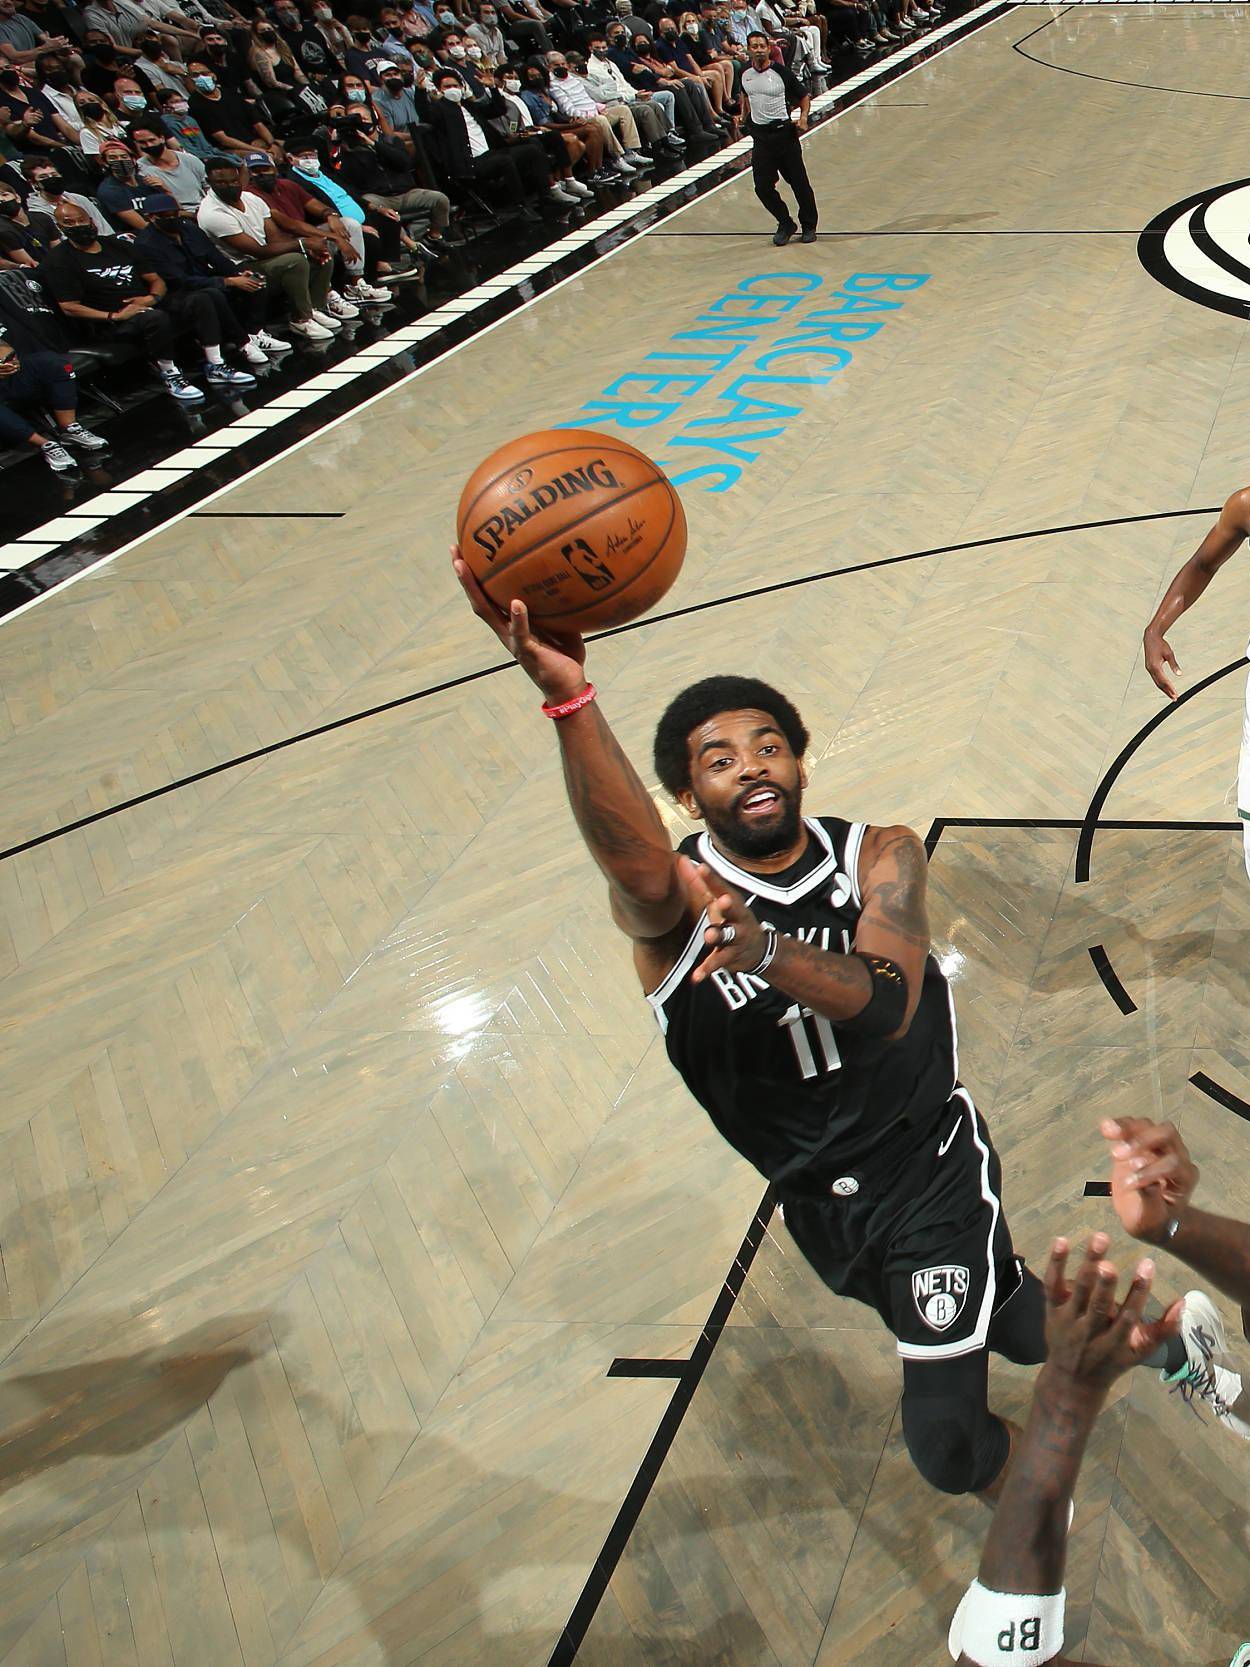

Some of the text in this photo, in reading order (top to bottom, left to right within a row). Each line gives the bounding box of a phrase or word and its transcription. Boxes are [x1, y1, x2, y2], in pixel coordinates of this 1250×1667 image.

[551, 271, 824, 428] CENTER
[657, 273, 934, 494] BARCLAYS
[472, 458, 617, 562] SPALDING
[776, 1003, 842, 1080] 11
[915, 1268, 967, 1298] NETS
[997, 1618, 1041, 1652] BP
